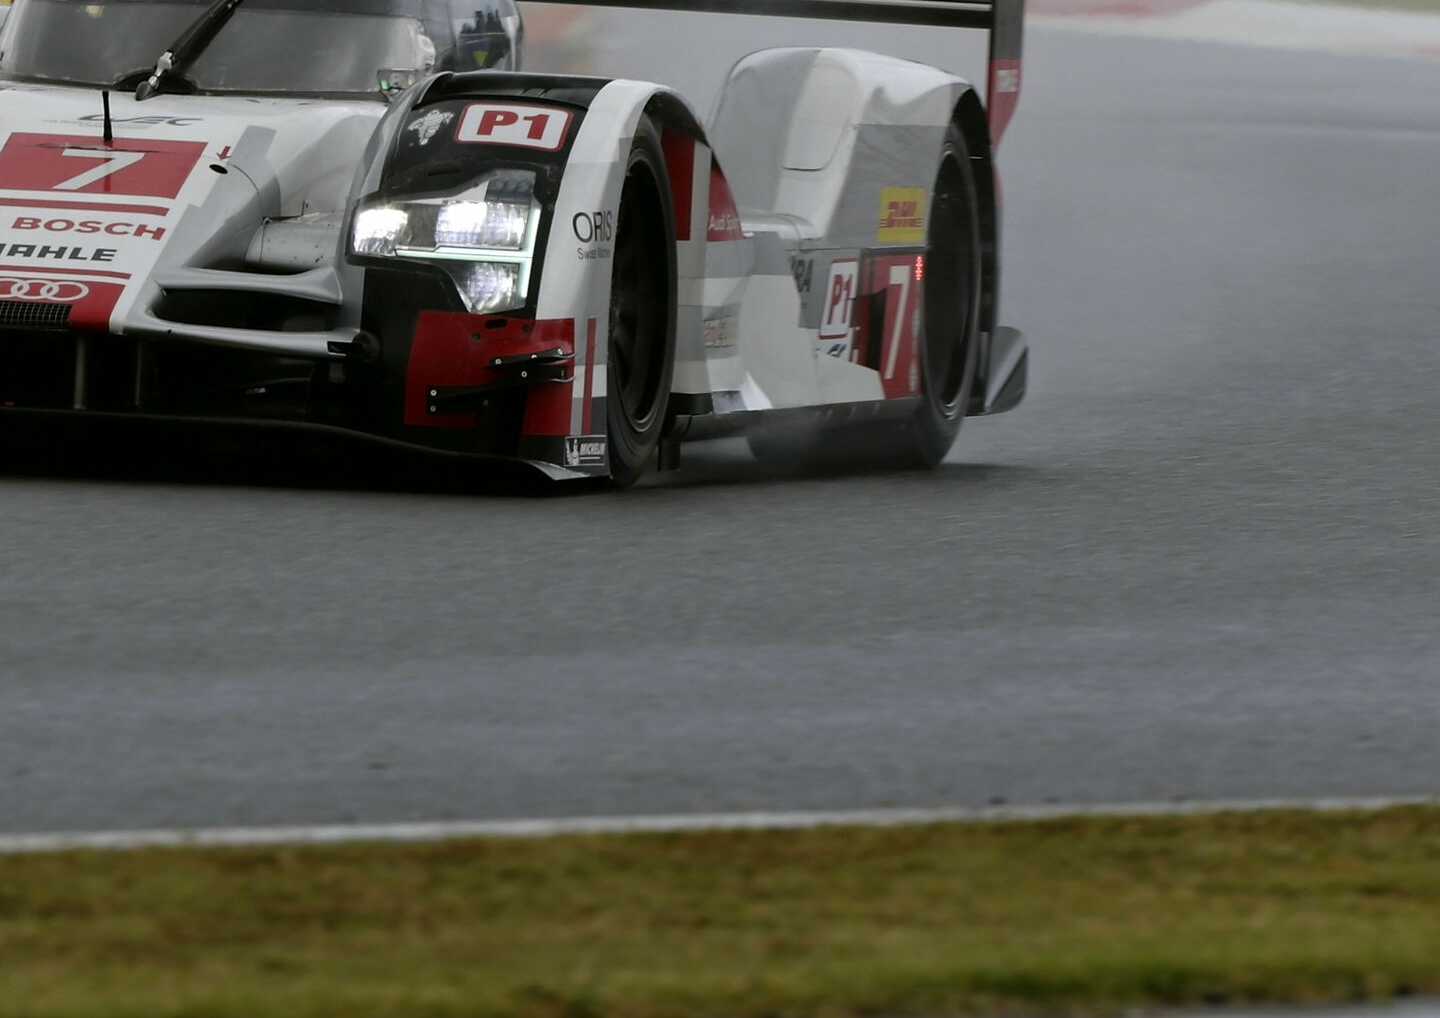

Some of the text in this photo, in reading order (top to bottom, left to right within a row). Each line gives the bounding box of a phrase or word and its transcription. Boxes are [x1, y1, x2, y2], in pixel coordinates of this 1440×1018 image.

[476, 110, 550, 140] P1
[51, 148, 146, 191] 7
[11, 217, 167, 241] BOSCH
[572, 210, 613, 243] ORIS
[827, 273, 853, 325] P1
[884, 265, 911, 379] 7
